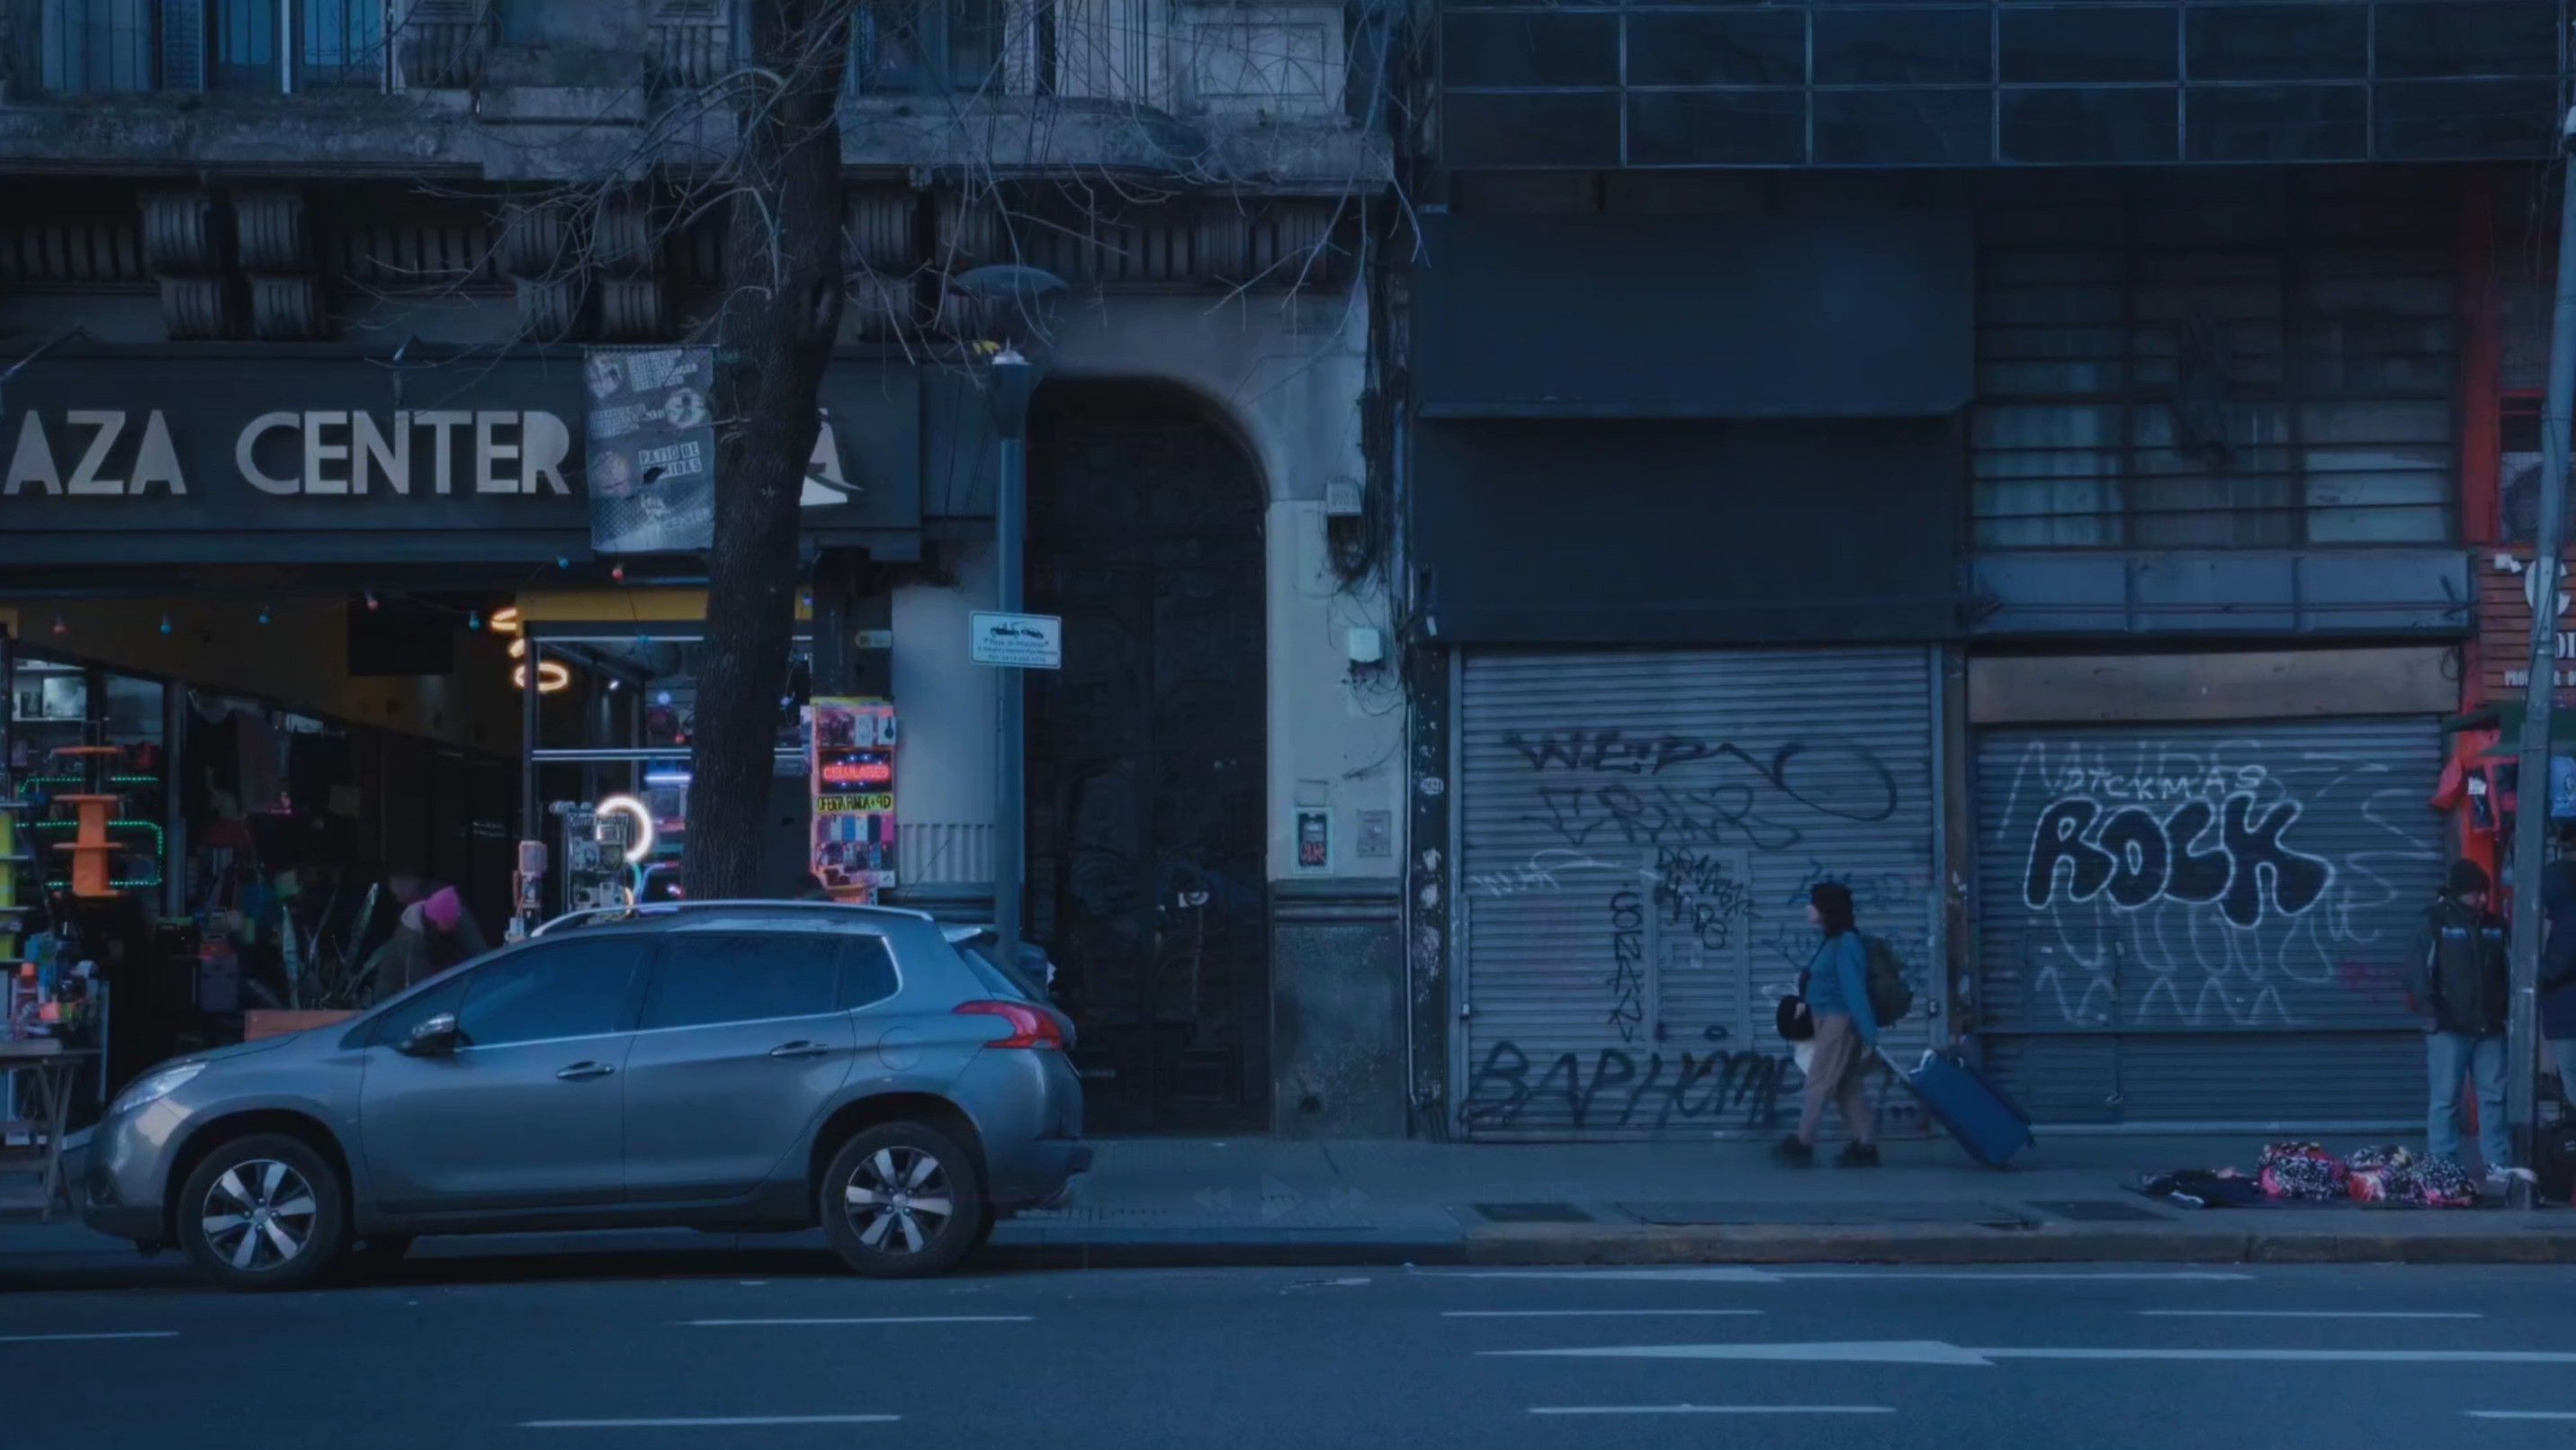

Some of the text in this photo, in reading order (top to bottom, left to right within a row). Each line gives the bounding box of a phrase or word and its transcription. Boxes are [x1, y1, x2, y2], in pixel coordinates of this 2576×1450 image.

[236, 409, 571, 495] CENTER
[640, 442, 699, 464] PATIO DE
[823, 765, 889, 779] CELULARES
[2024, 790, 2336, 930] ROCK
